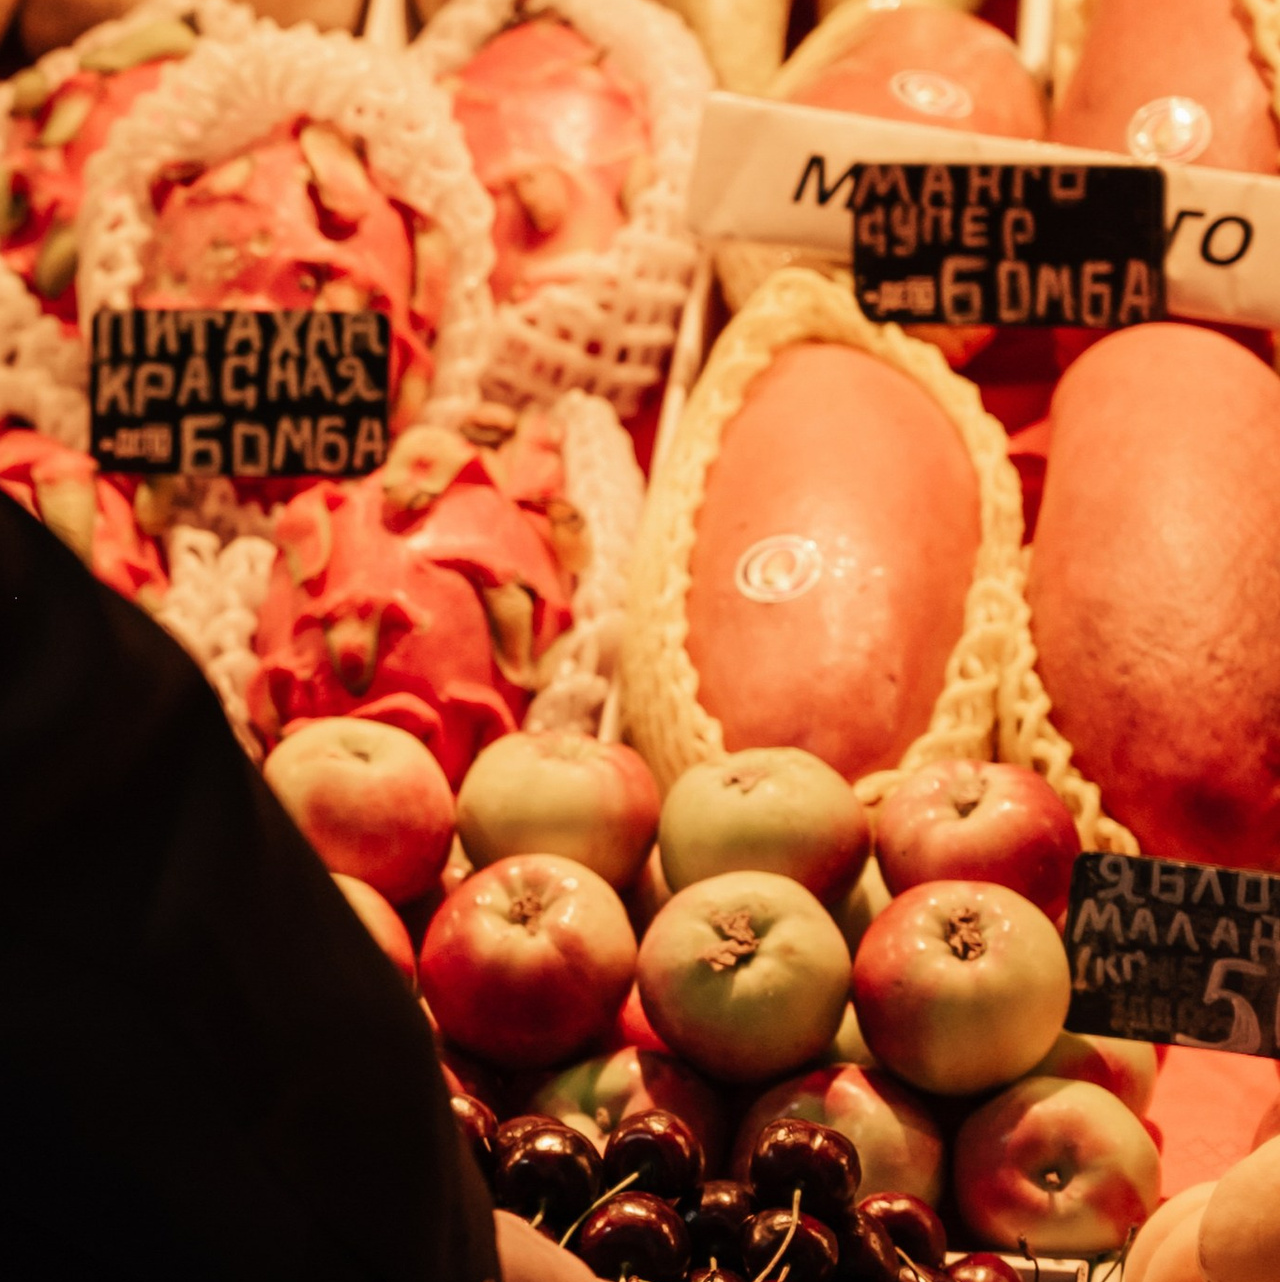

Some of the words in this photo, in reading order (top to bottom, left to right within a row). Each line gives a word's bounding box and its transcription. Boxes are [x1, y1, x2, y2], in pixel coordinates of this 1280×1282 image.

[941, 254, 1152, 326] БОМБА
[95, 356, 385, 416] КРАСНАЯ
[179, 413, 386, 476] БОМБА
